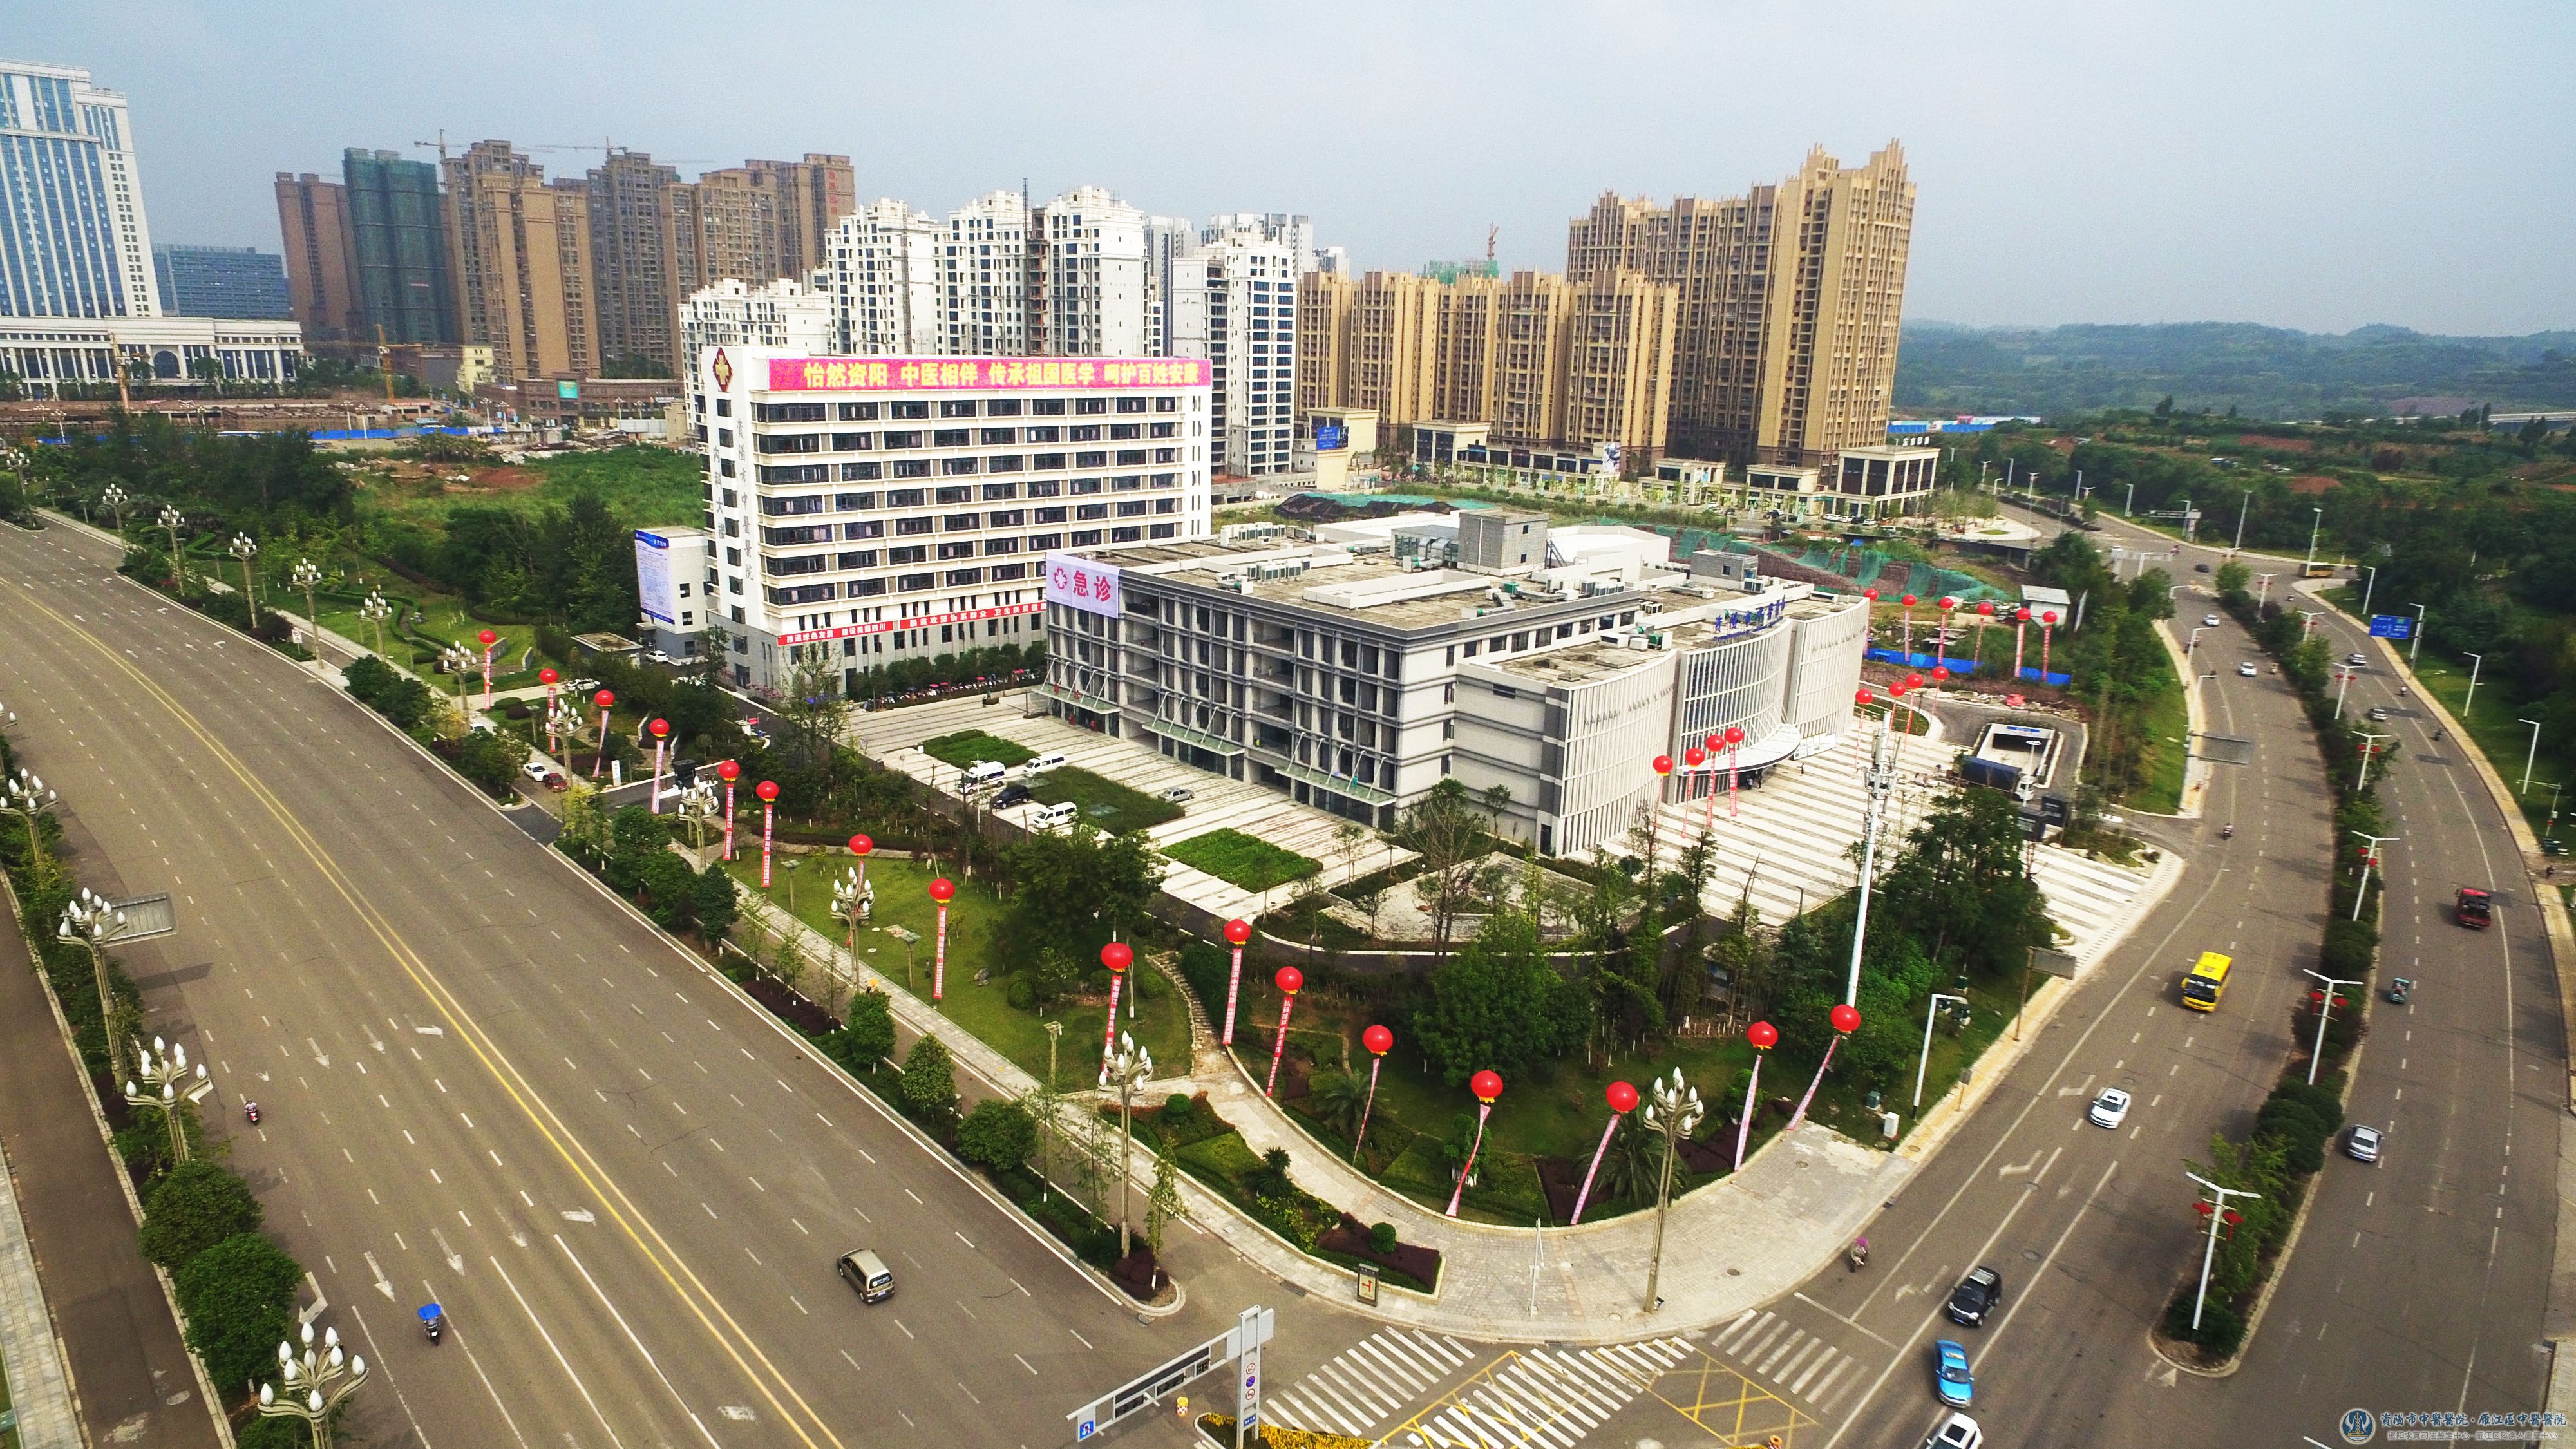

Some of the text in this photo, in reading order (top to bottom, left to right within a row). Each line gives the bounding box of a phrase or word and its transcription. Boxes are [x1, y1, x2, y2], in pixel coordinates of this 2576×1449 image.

[804, 362, 887, 387] 怡然资阳
[900, 362, 978, 386] 中医相伴
[989, 362, 1095, 385] 传承祖国医学
[1073, 569, 1112, 603] 急诊
